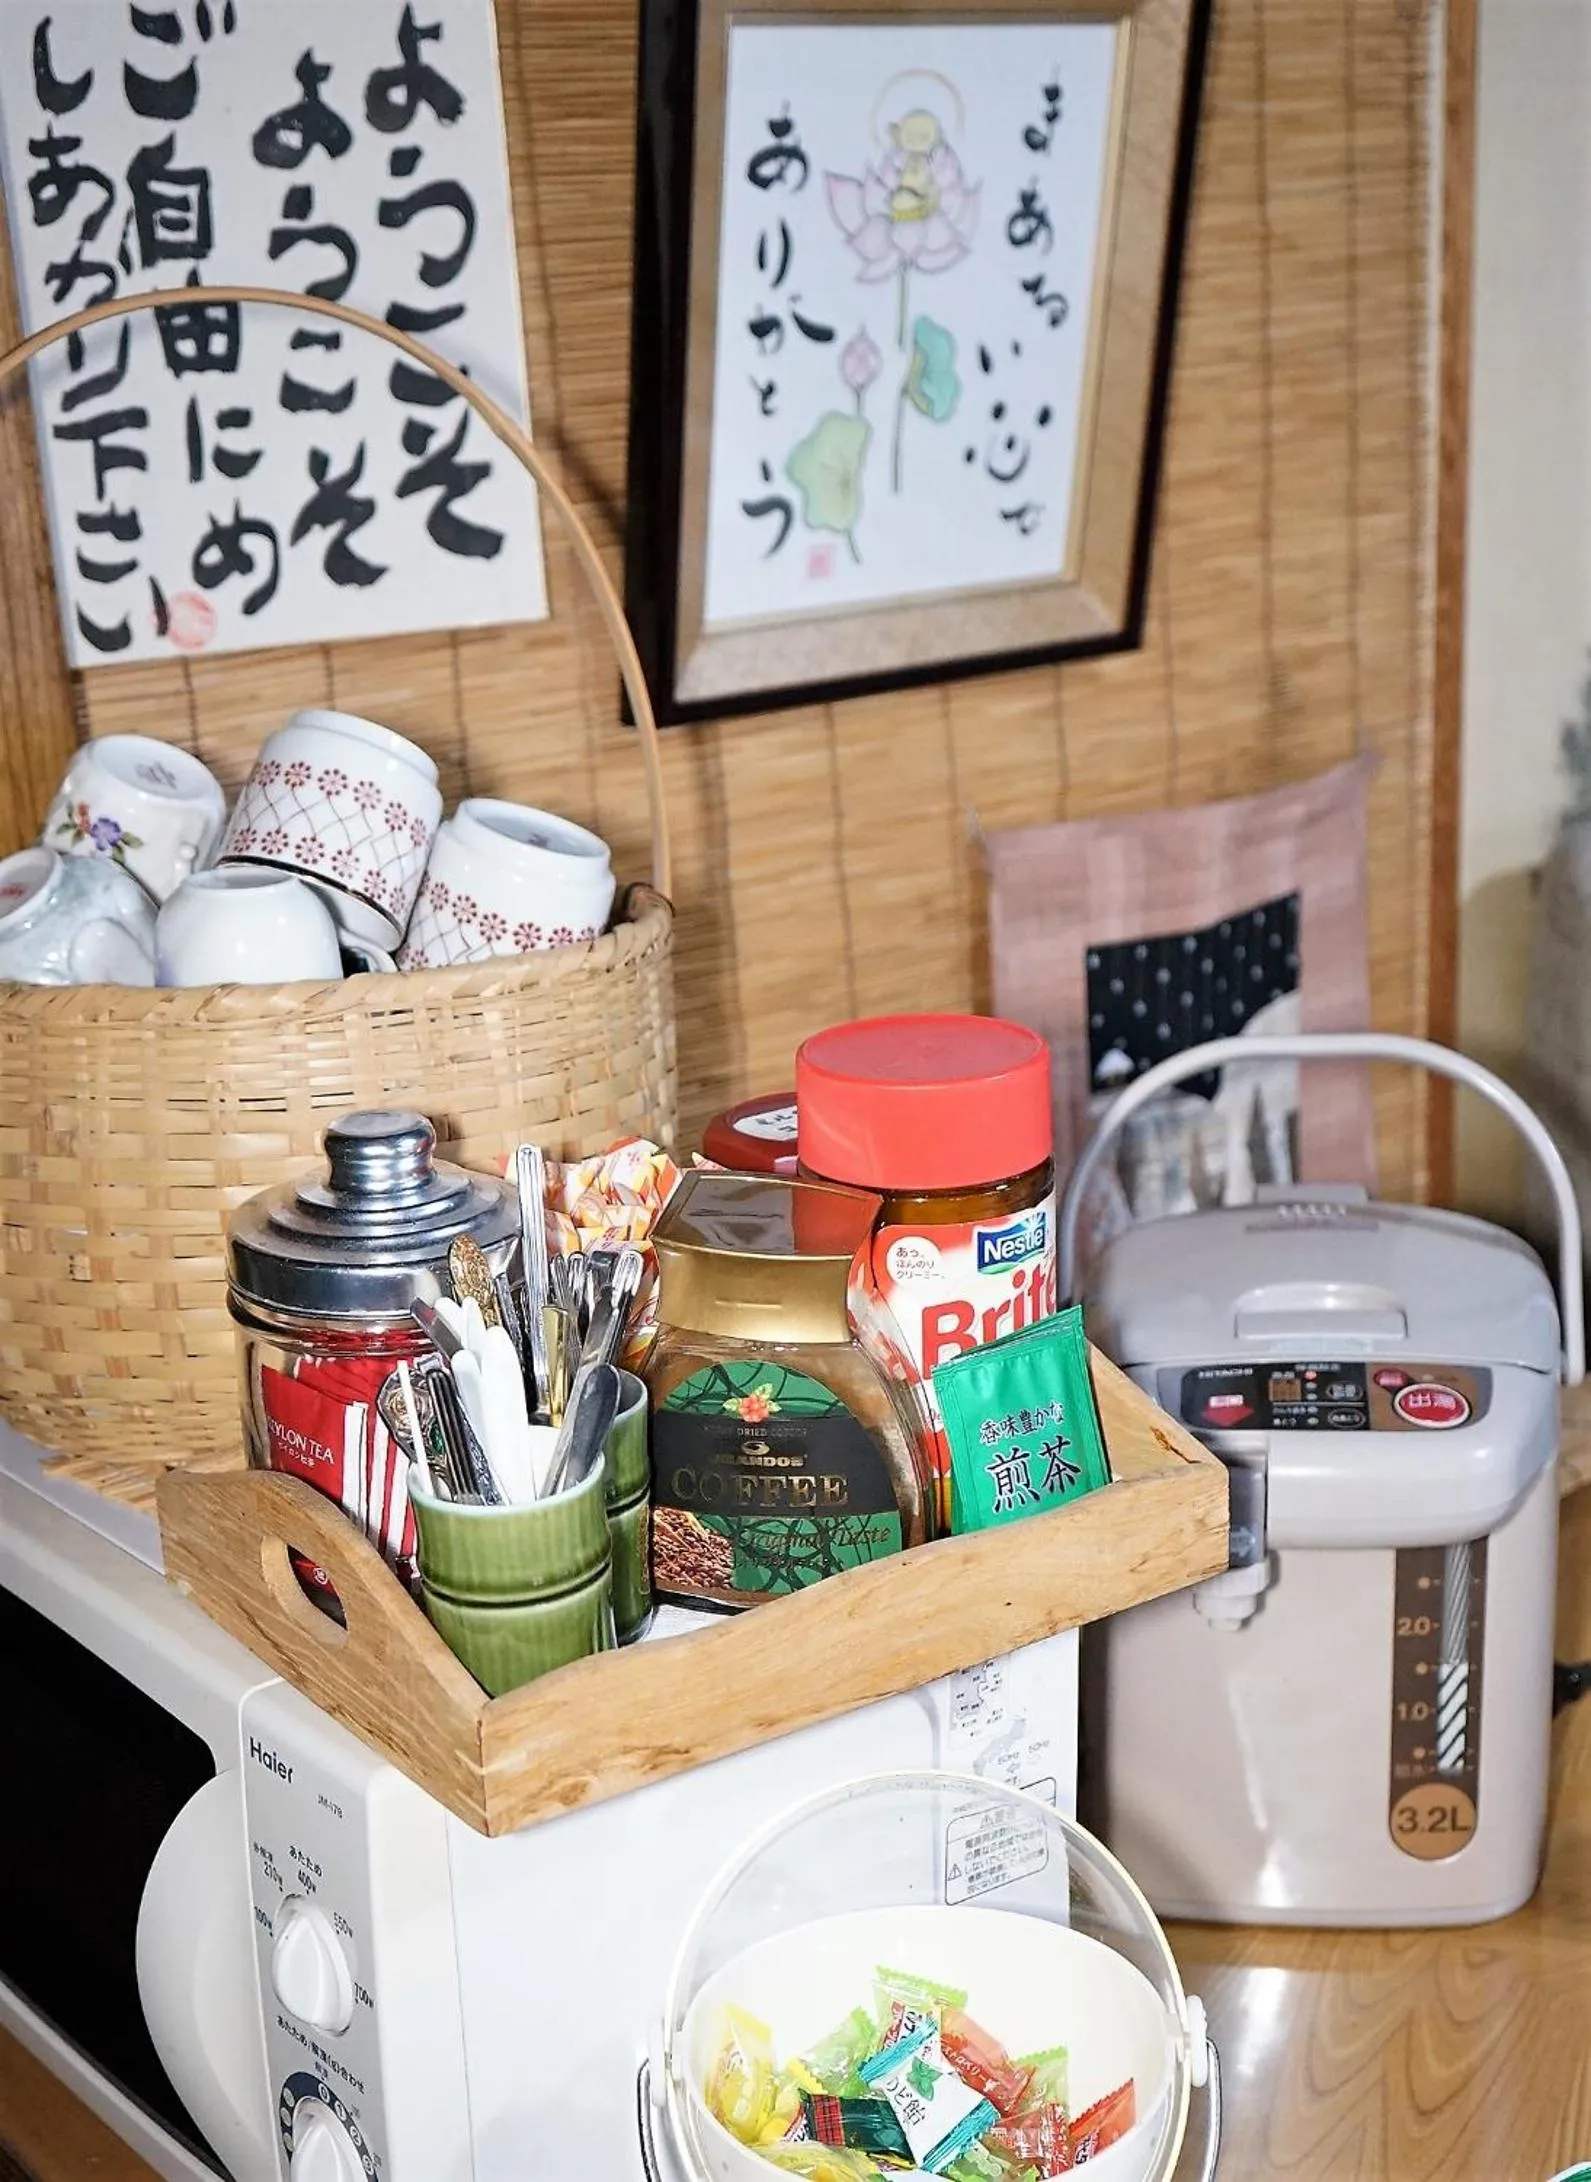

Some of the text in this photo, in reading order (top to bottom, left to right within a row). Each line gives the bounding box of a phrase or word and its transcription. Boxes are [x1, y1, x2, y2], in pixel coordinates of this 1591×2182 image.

[363, 5, 505, 560] ようこそ
[252, 48, 390, 587] ようこそ
[980, 1401, 1064, 1444] 香味豊かな
[309, 1439, 335, 1465] TEA
[986, 1435, 1082, 1514] 煎茶
[670, 1467, 849, 1509] COFFEE
[250, 1736, 294, 1784] Haier
[1397, 1806, 1472, 1833] 3.2L
[885, 2076, 927, 2127] のど飴
